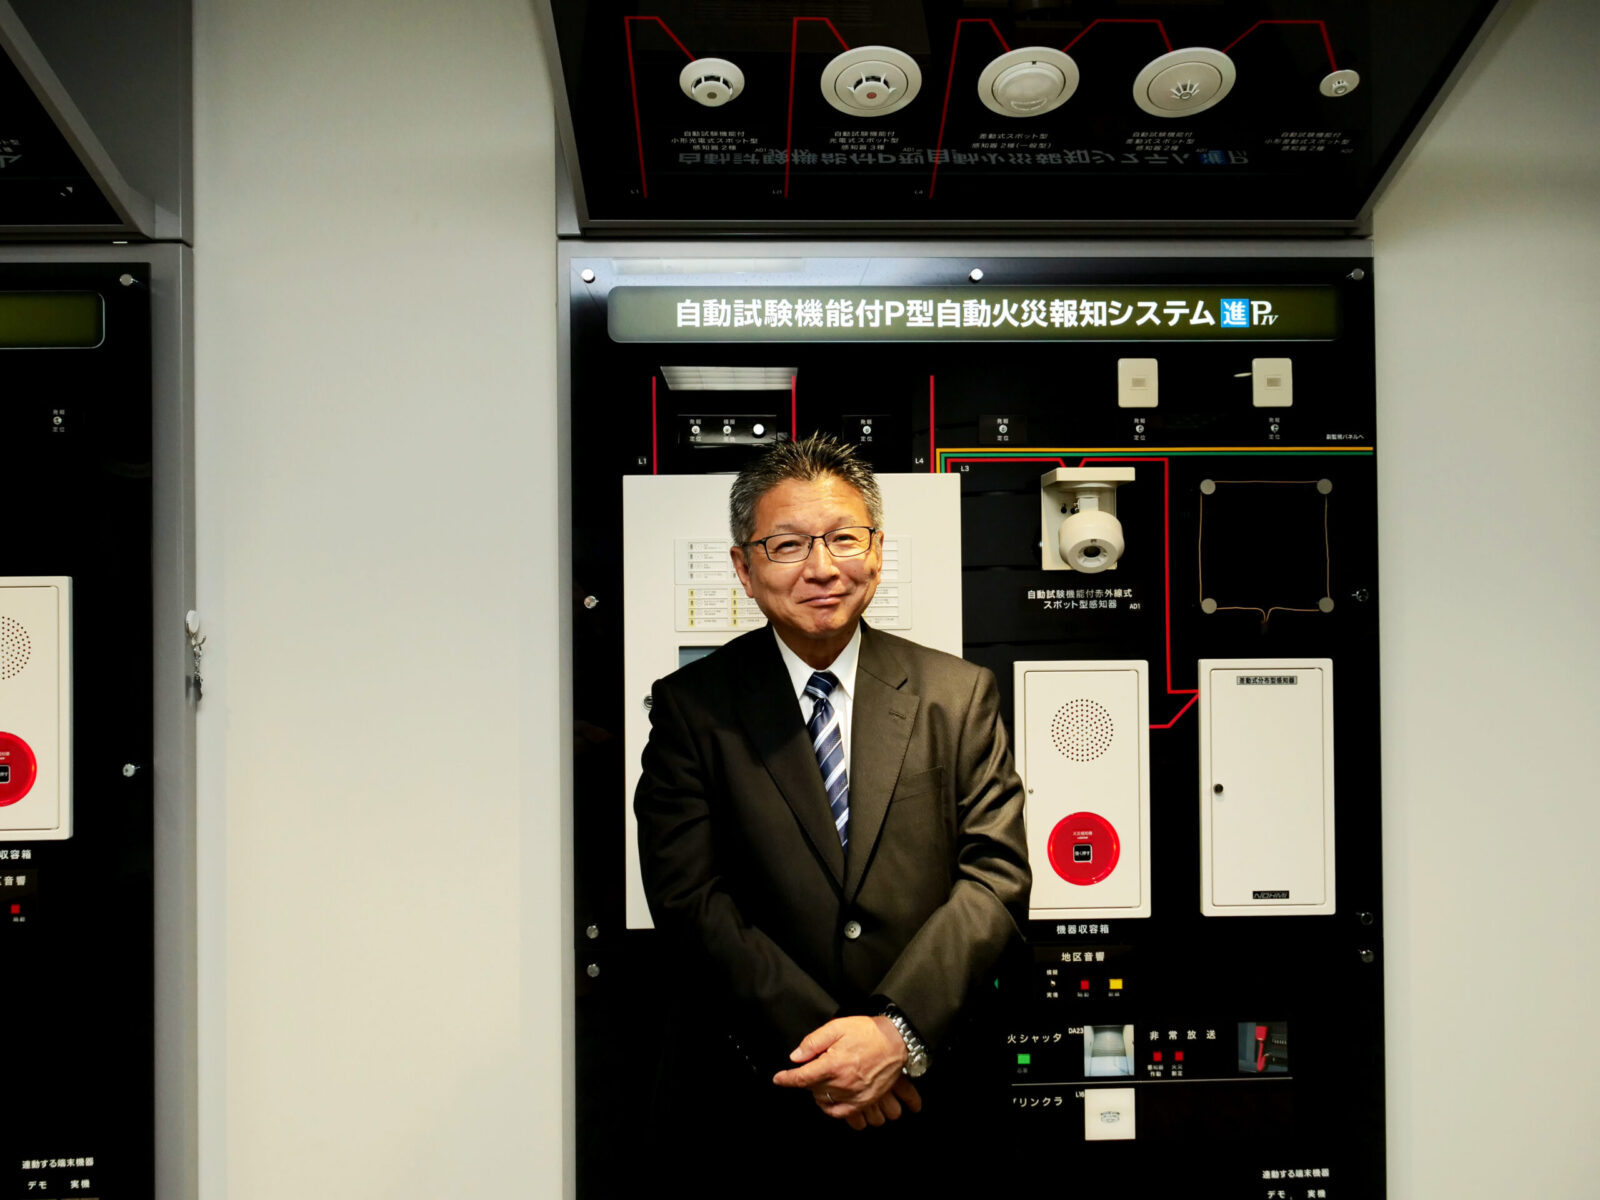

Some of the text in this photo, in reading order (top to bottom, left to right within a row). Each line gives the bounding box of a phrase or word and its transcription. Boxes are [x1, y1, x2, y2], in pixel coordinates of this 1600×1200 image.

[676, 298, 1216, 328] 自動試験機能付P型自動火災報知システム
[1027, 588, 1132, 599] 自動試験機能付赤外線式
[1043, 599, 1117, 609] スポット型感知器
[0, 875, 26, 886] 音響
[1056, 924, 1109, 935] 機器収容箱
[1061, 951, 1105, 962] 地区音響
[27, 1180, 48, 1190] デモ
[1267, 1190, 1286, 1199] デモ
